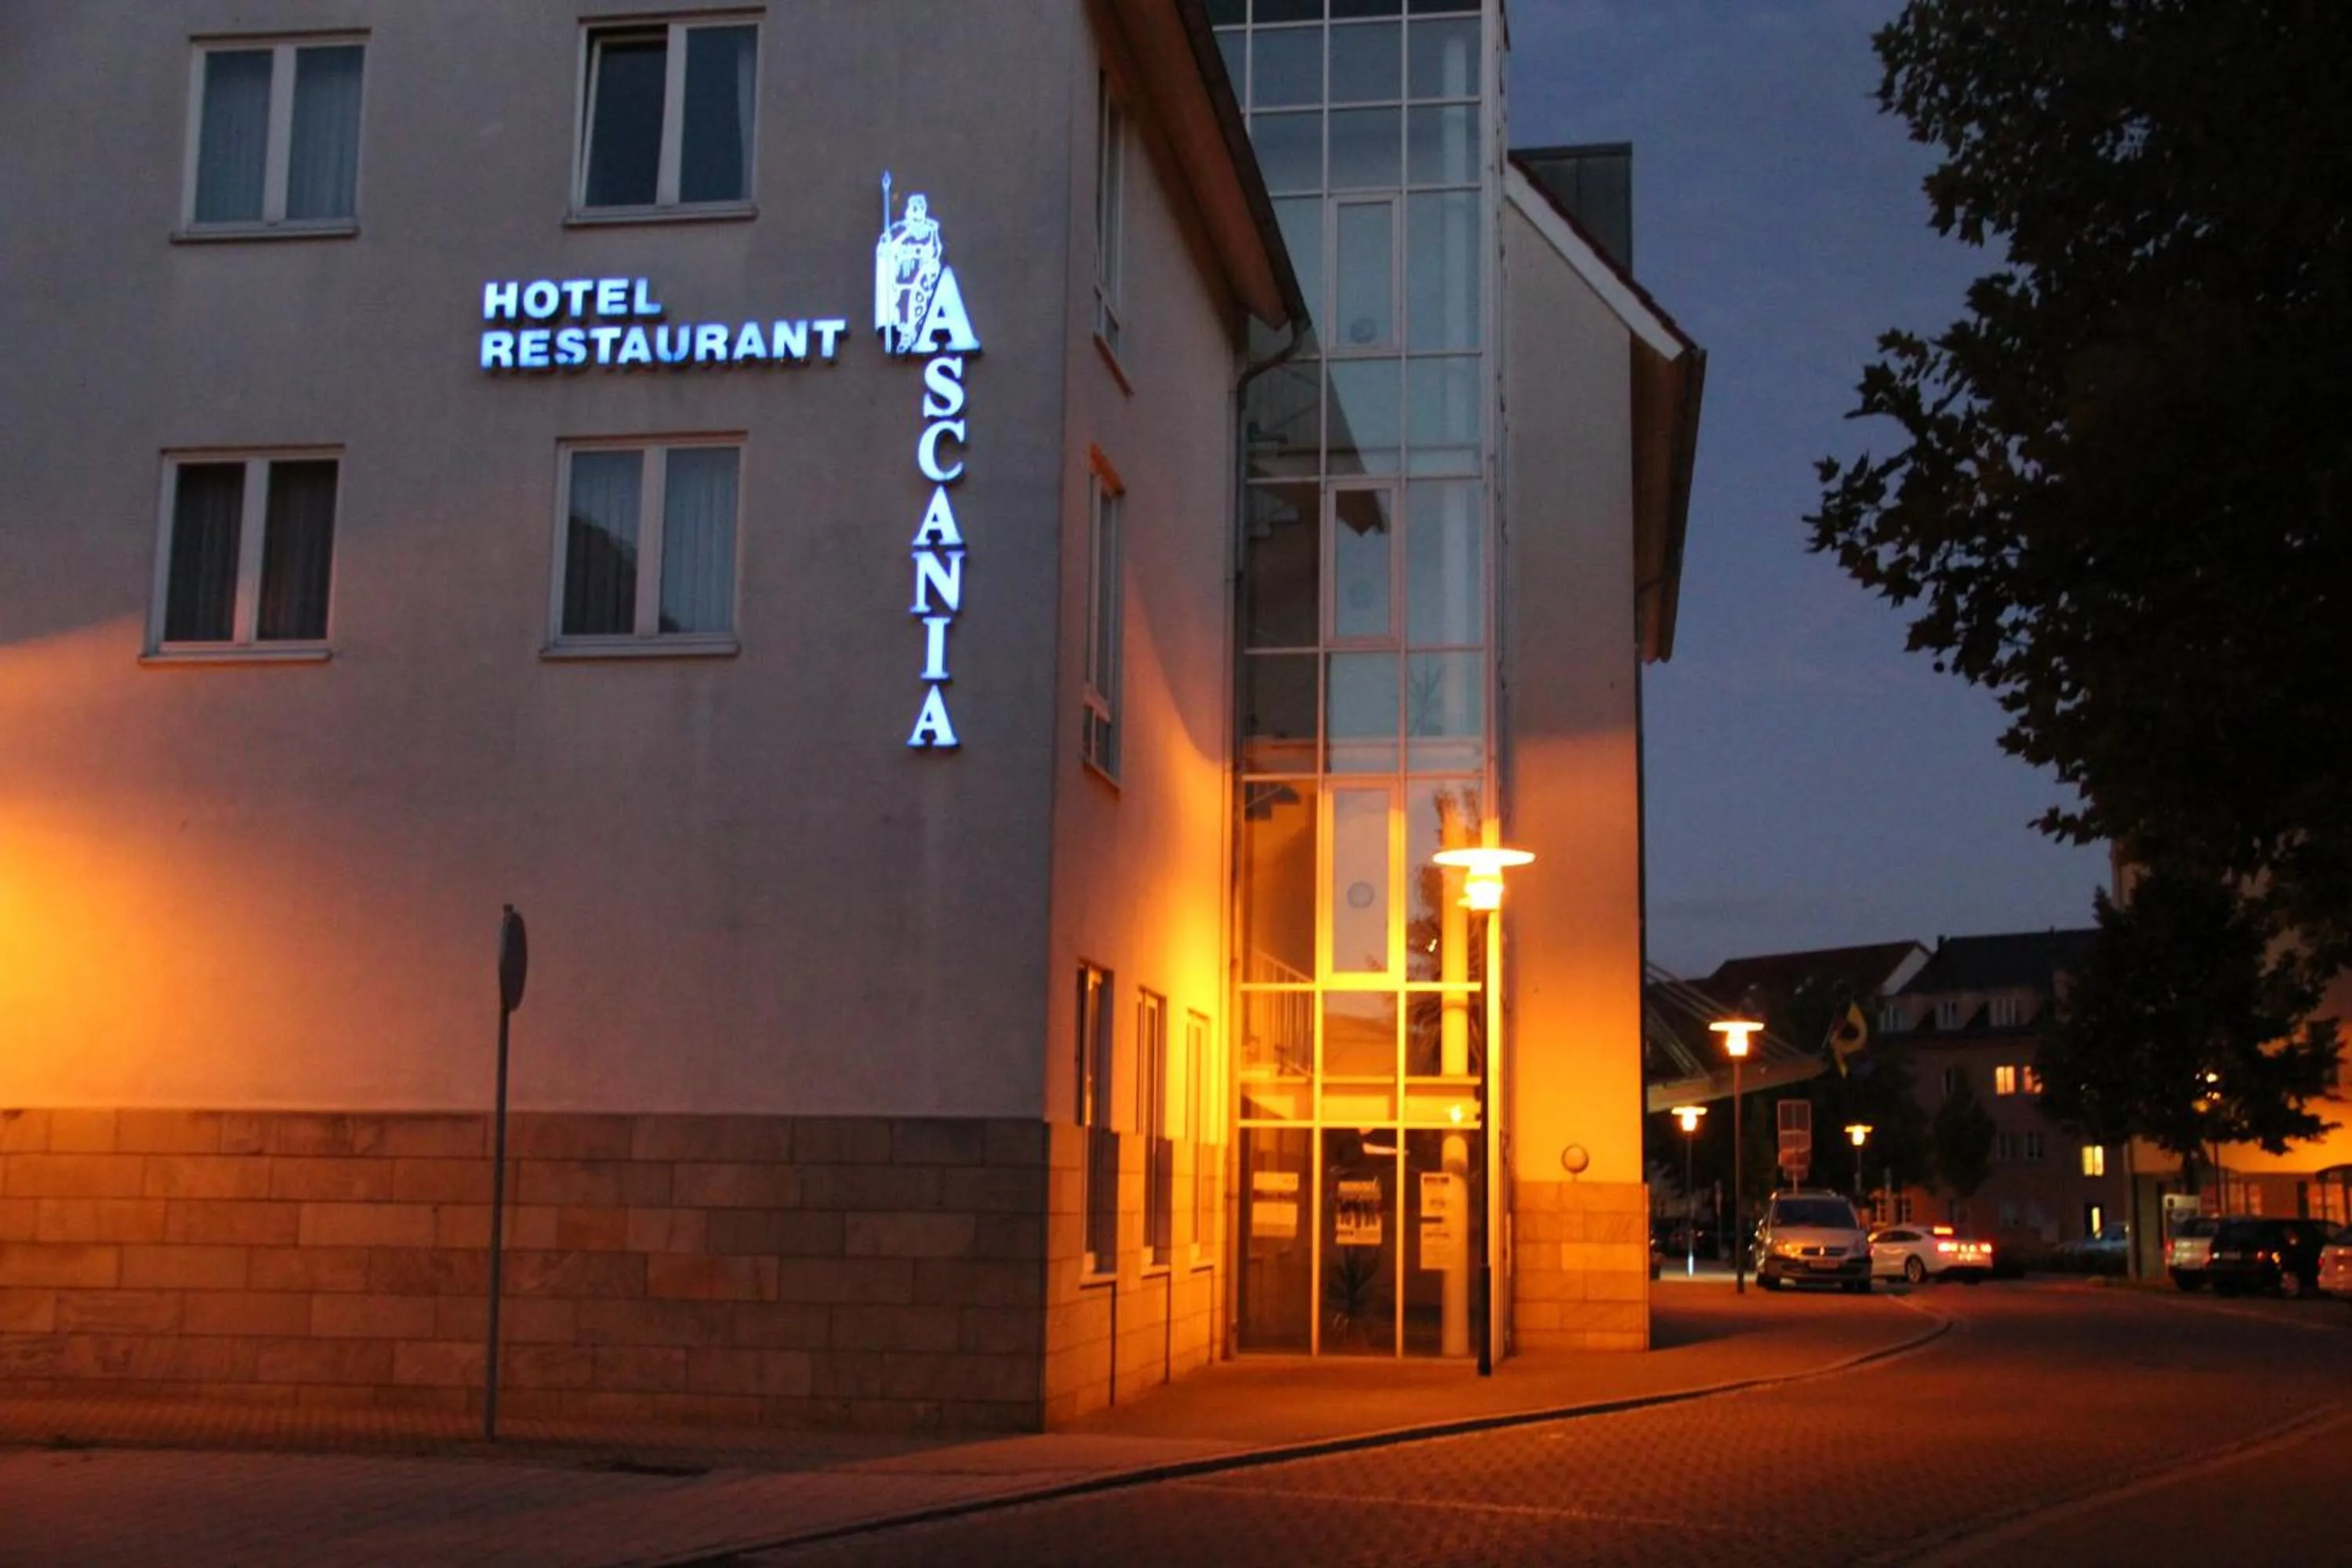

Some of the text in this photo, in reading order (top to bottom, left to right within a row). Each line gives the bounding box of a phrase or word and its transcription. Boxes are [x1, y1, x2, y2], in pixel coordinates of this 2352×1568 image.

[482, 278, 662, 318] HOTEL
[480, 319, 846, 368] RESTAURANT
[907, 265, 981, 746] ASCANIA
